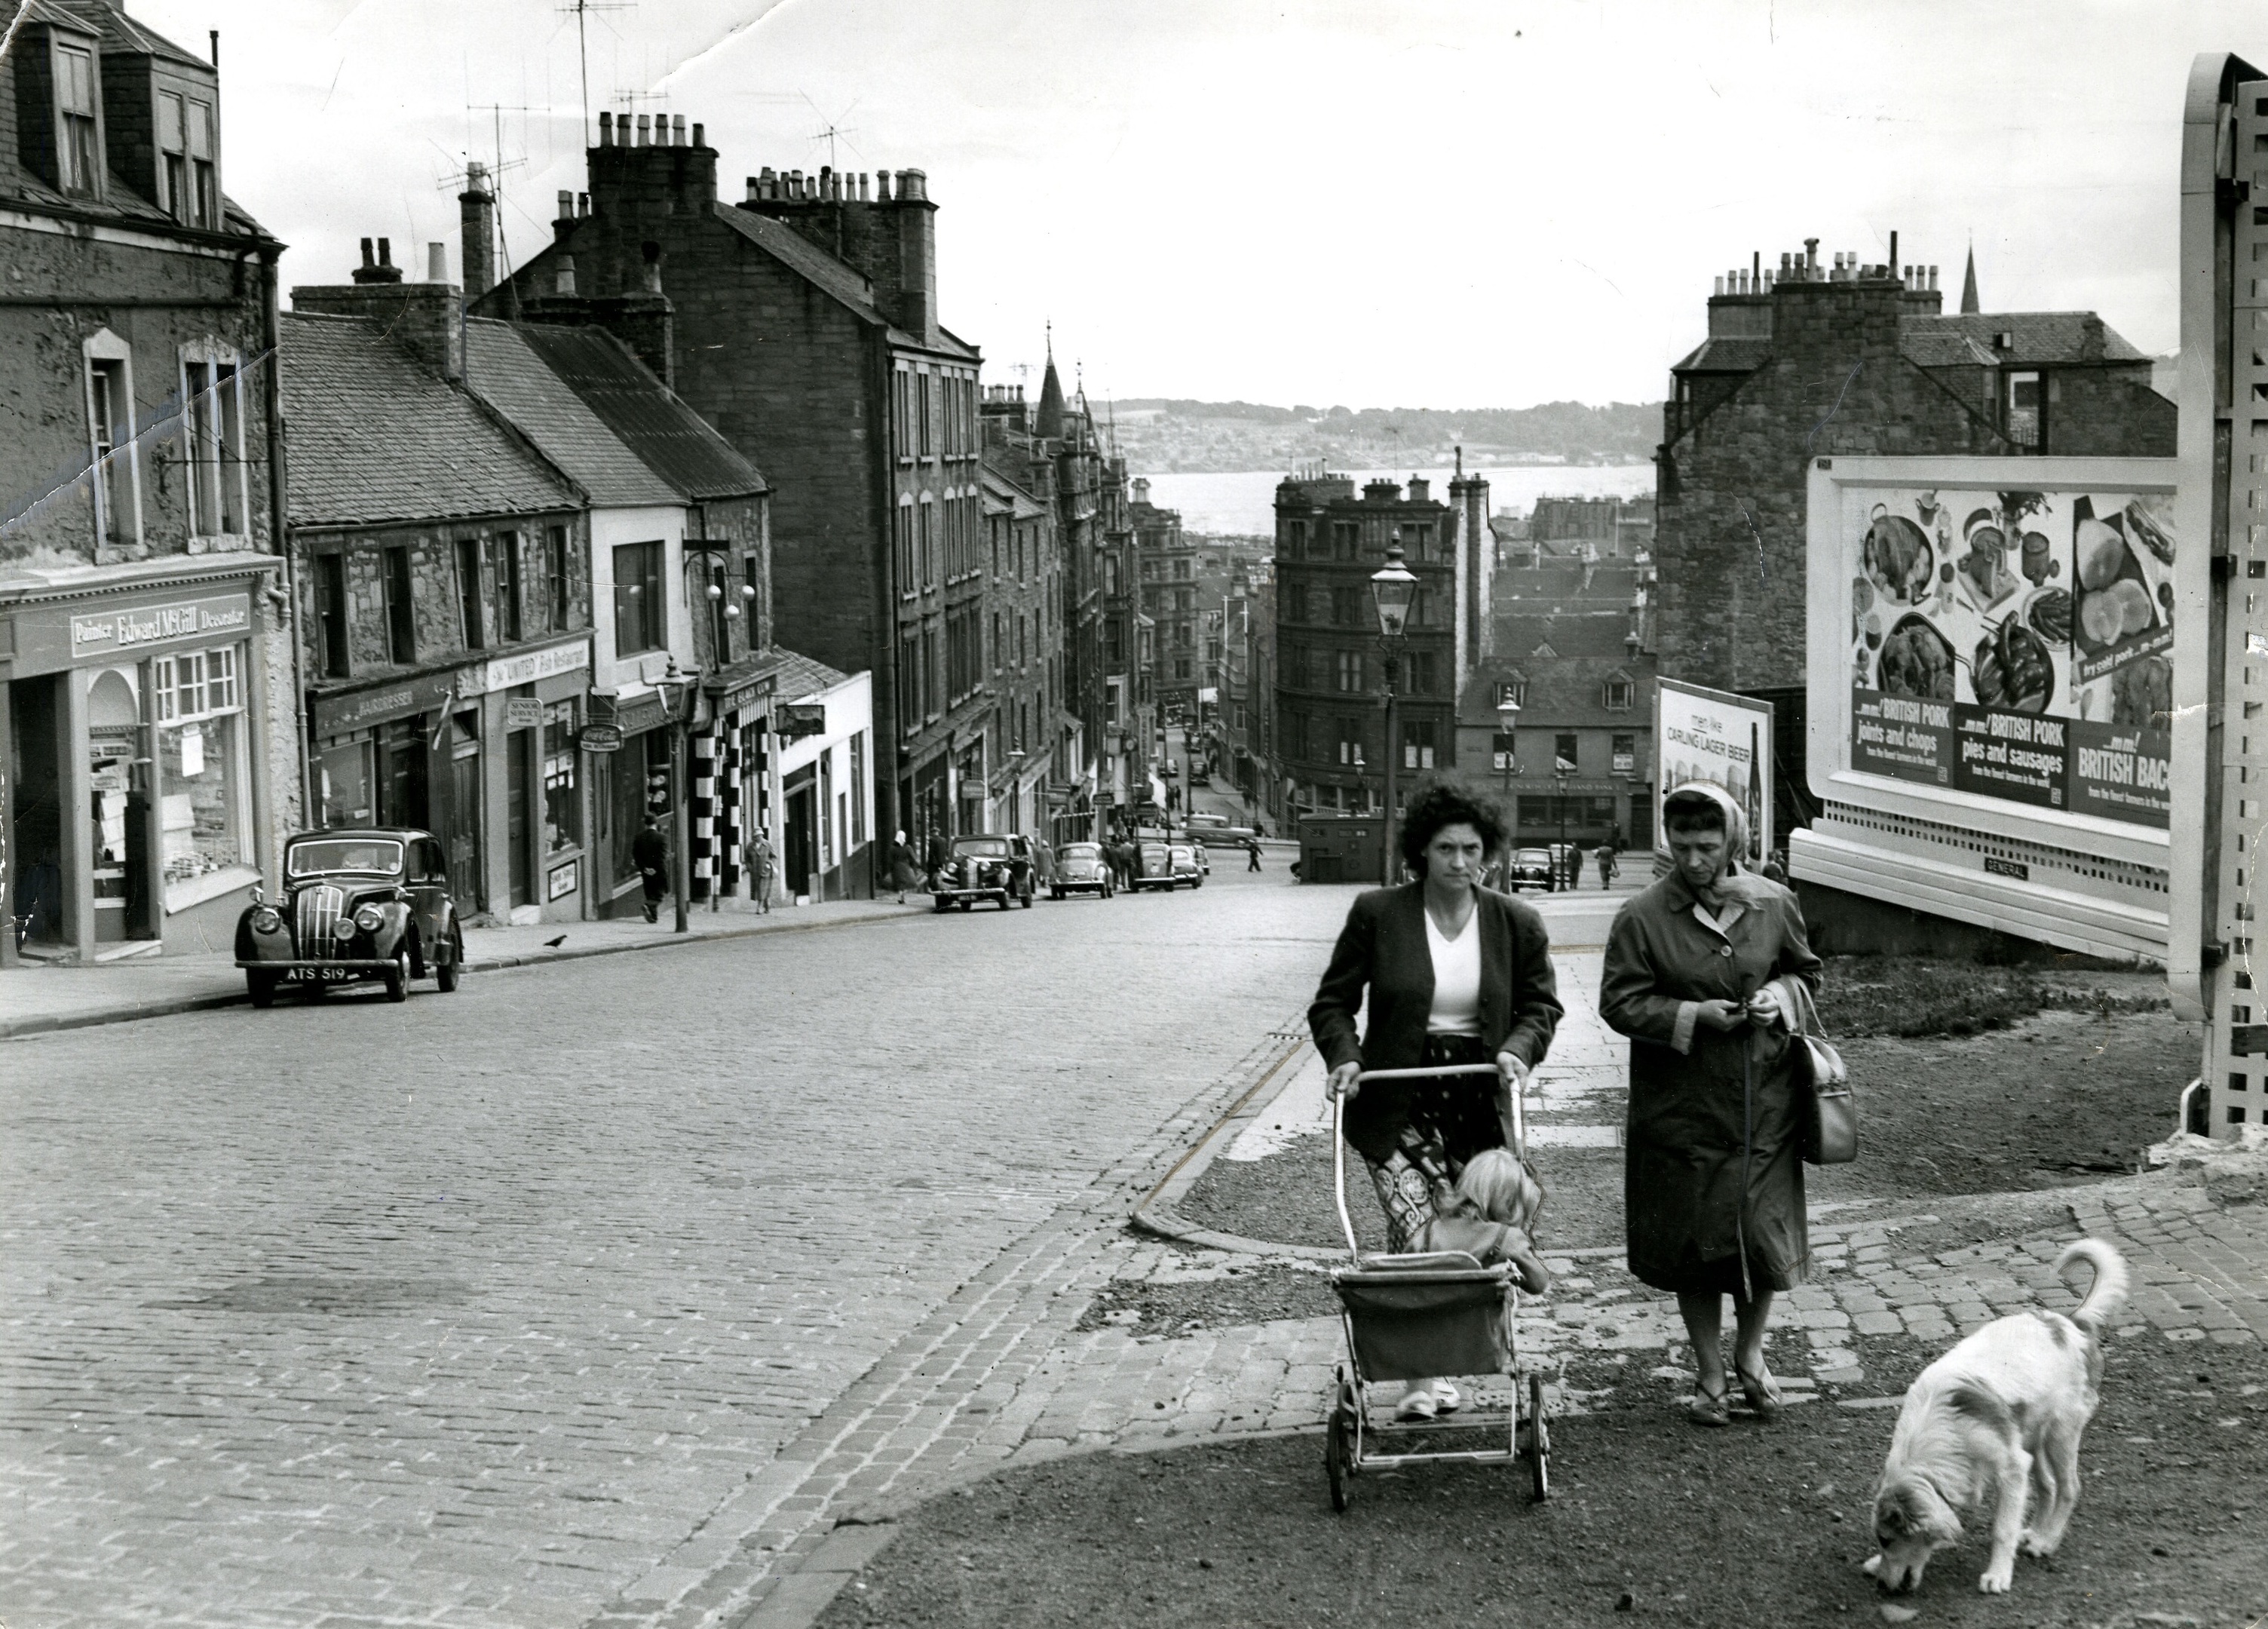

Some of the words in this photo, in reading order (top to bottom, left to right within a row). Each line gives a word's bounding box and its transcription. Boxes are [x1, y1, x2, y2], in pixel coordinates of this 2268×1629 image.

[75, 621, 112, 644] Painter
[117, 612, 161, 645] Edward
[201, 609, 244, 630] Decorator
[2083, 664, 2096, 676] try
[2096, 654, 2113, 672] cold
[1883, 698, 1920, 724] BRITISH
[1922, 703, 1950, 729] PORK
[1991, 713, 2032, 742] BRITISH
[2034, 719, 2065, 747] PORK
[1667, 726, 1699, 749] CARLING
[1700, 735, 1727, 757] LAGER
[1728, 744, 1750, 763] BEER
[1856, 719, 1884, 744] joints
[1886, 725, 1905, 747] and
[1906, 727, 1938, 756] chops
[1963, 737, 1985, 762] pies
[1987, 741, 2007, 763] and
[2009, 749, 2064, 777] sausages
[2079, 747, 2134, 785] BRITISH
[1988, 860, 2024, 877] GENERAL
[287, 968, 315, 980] ATS
[321, 968, 345, 980] 519
